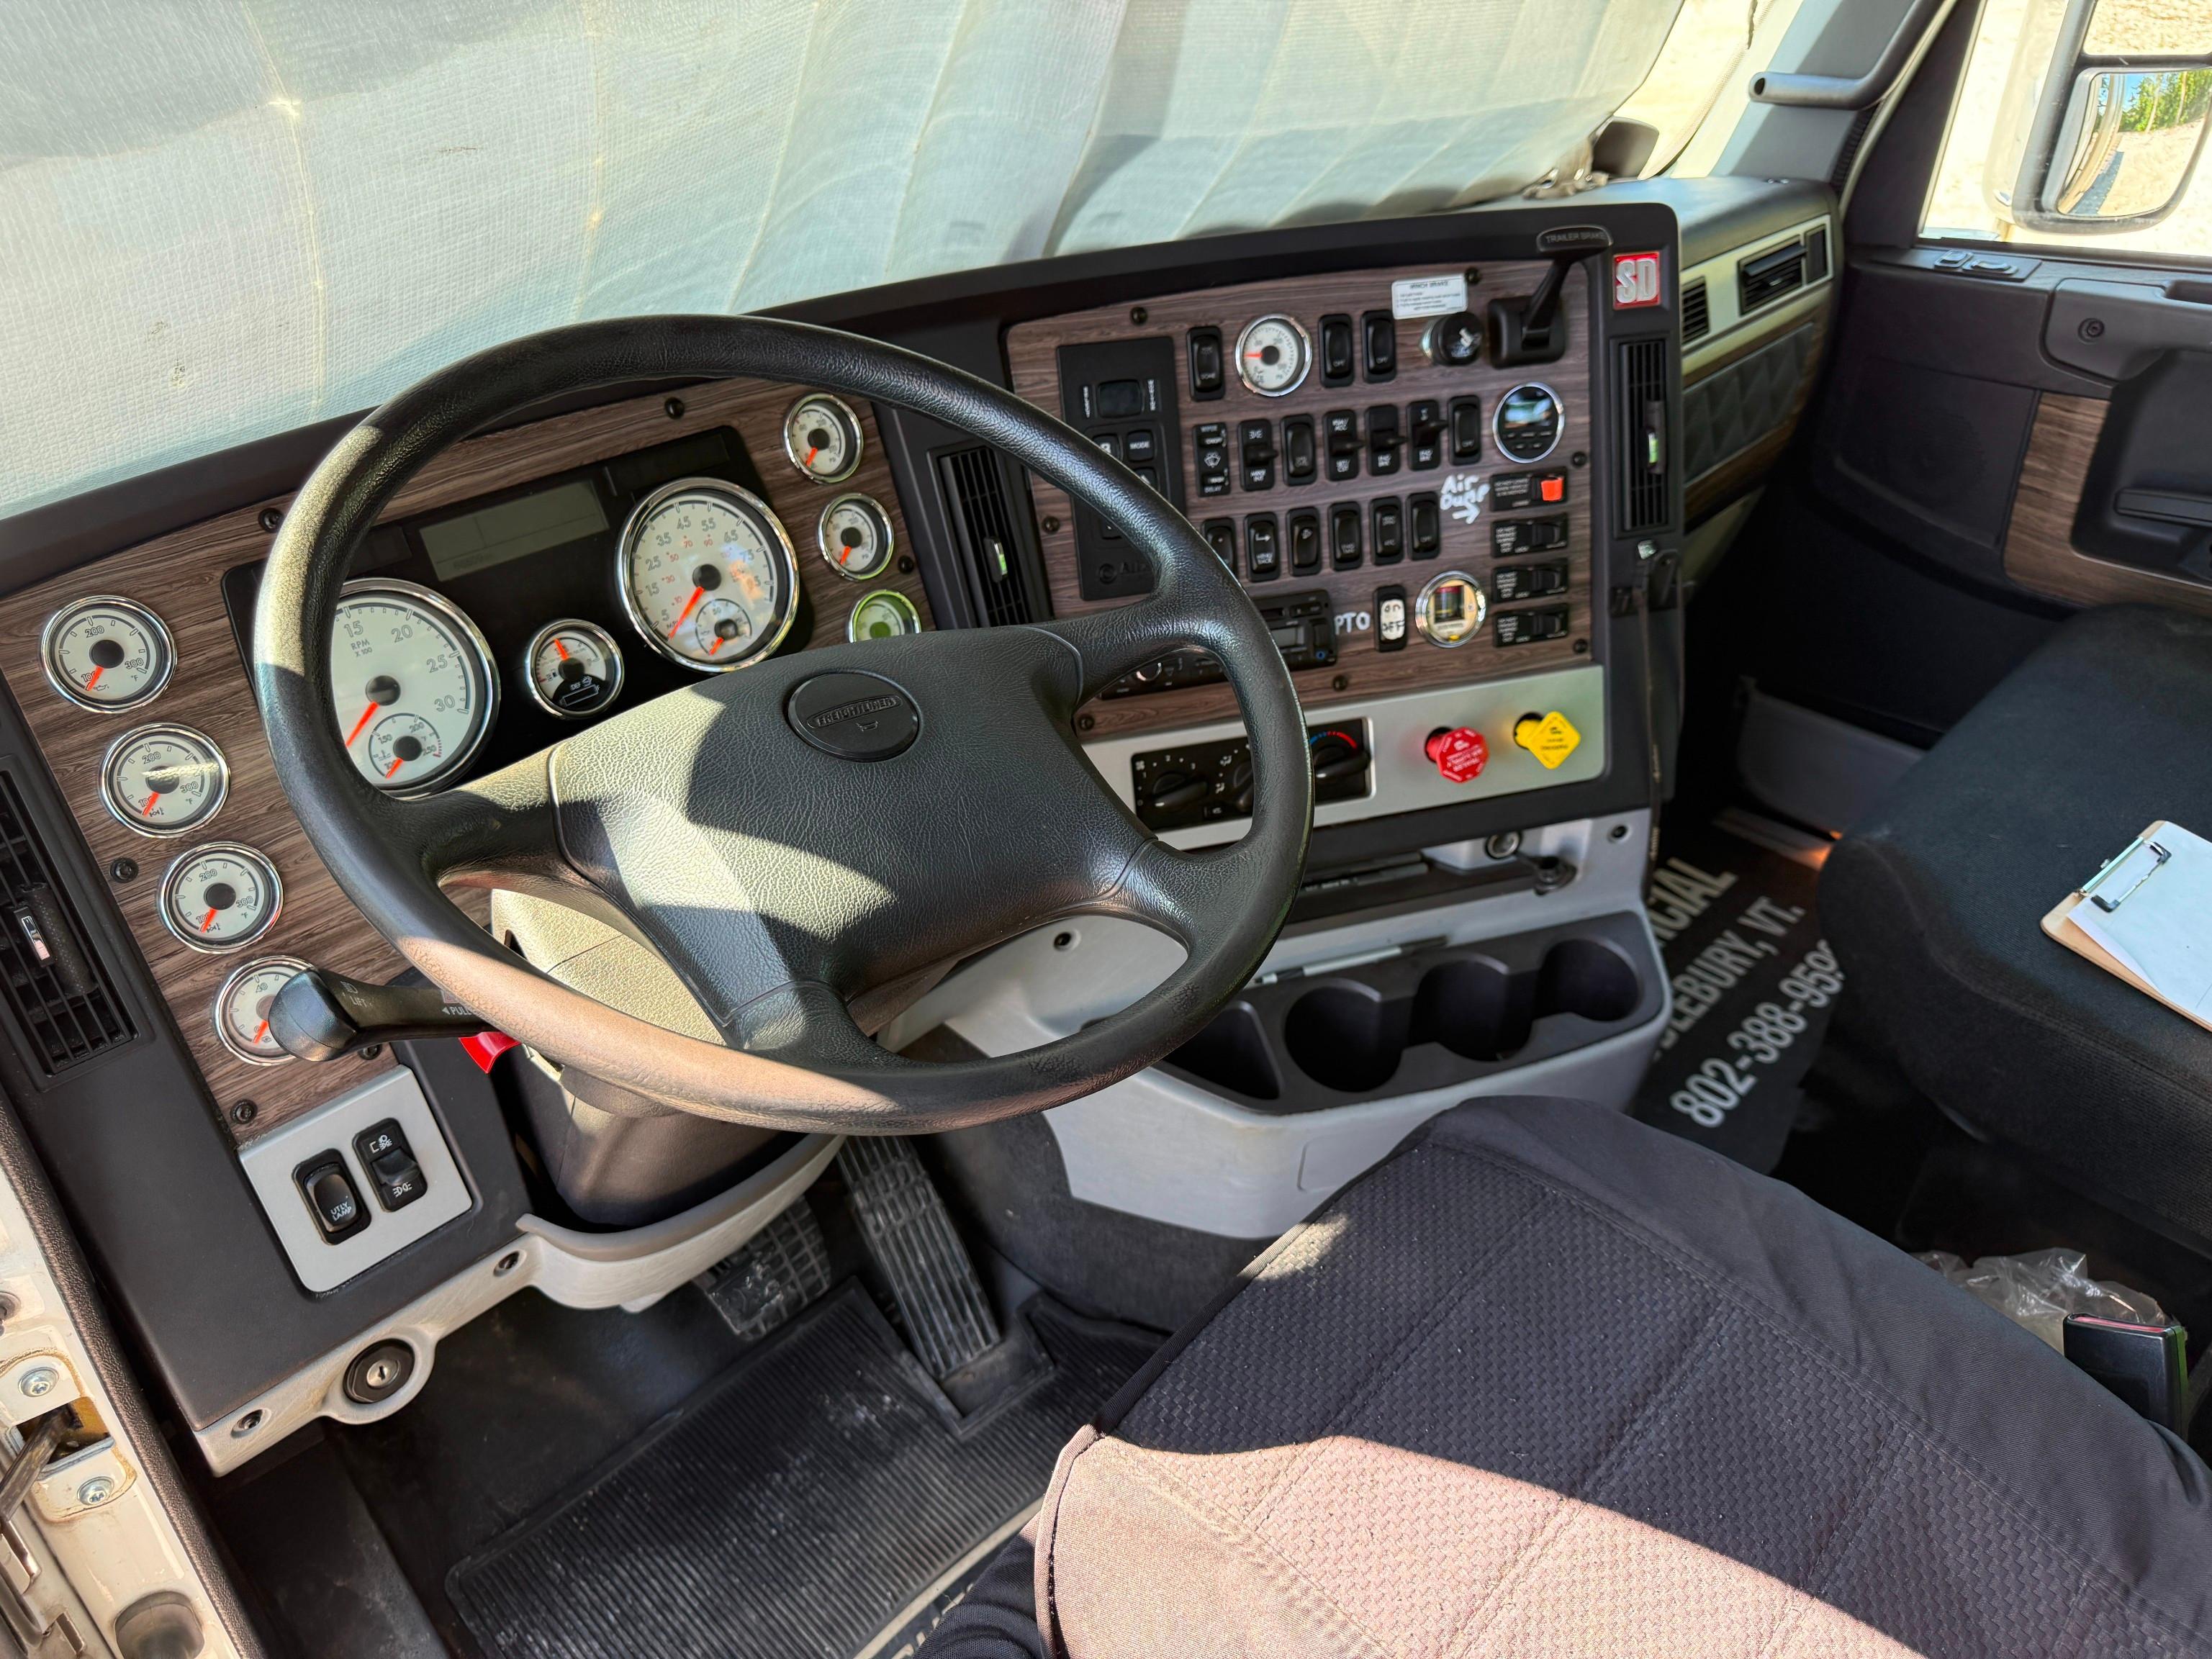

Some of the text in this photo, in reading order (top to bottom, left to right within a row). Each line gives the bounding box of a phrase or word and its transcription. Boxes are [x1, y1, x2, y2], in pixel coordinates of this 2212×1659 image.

[1545, 230, 1608, 243] TRAILER BRAKE
[1616, 257, 1658, 304] SD
[1440, 474, 1480, 494] Air
[701, 517, 716, 531] 55
[656, 532, 672, 546] 35
[645, 555, 662, 571] 25
[646, 582, 660, 597] 15
[343, 620, 364, 638] 15
[1334, 612, 1371, 635] PTO
[84, 625, 105, 638] 200
[391, 625, 413, 643] 20
[351, 638, 370, 651] RPM
[124, 657, 144, 670] 300
[426, 654, 448, 673] 25
[434, 695, 456, 712] 30
[816, 696, 897, 726] FREIGHTLINER
[142, 751, 161, 764] 200
[180, 782, 199, 793] 300
[199, 869, 217, 882] 200
[235, 895, 253, 908] 300
[1656, 895, 1806, 1059] EBURY, VT.
[350, 995, 367, 1008] LIFT
[333, 1206, 352, 1221] LAMP
